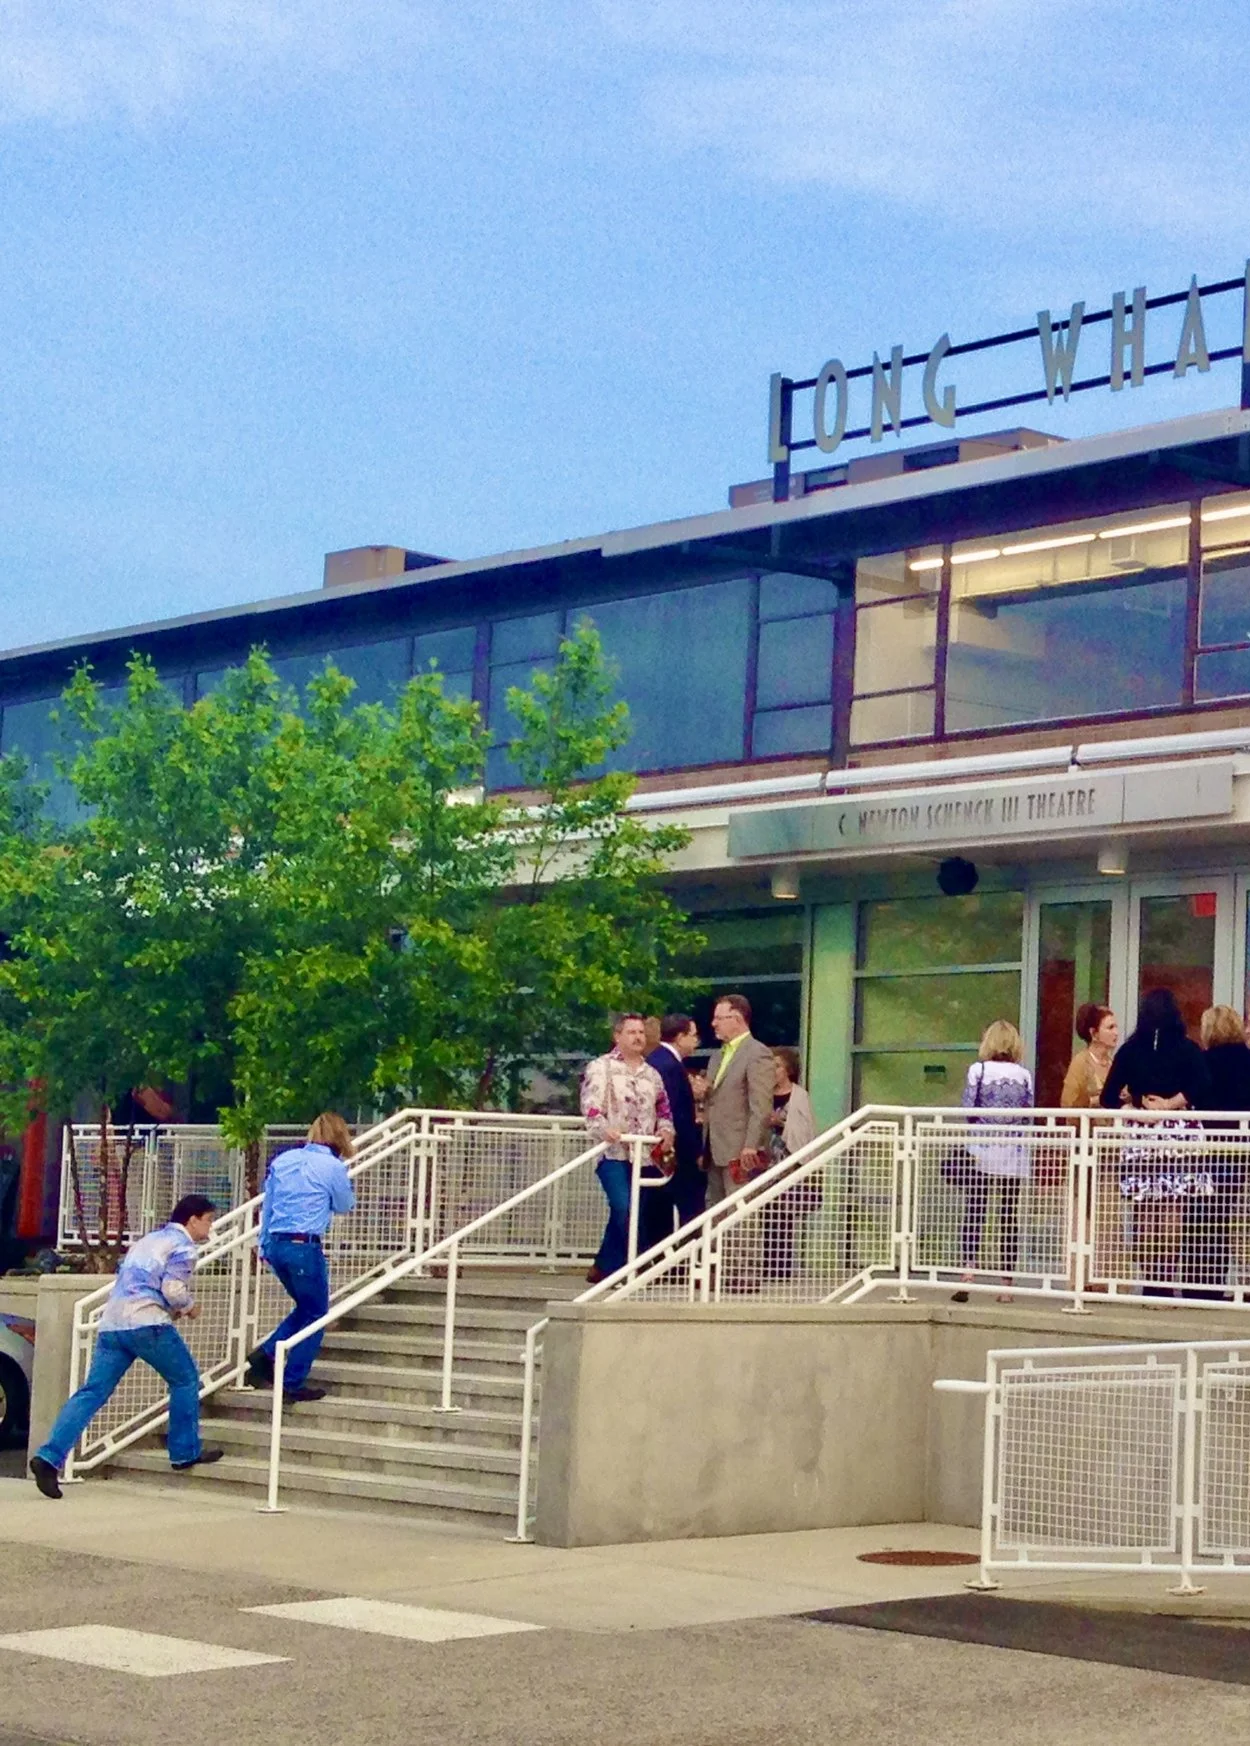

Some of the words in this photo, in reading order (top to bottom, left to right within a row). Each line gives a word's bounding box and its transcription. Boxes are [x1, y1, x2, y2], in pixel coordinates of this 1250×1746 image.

[768, 331, 956, 464] LONG
[858, 806, 920, 835] NEWTON
[926, 798, 994, 829] SCHENCK
[1001, 795, 1020, 823] III
[1027, 788, 1097, 820] THEATRE
